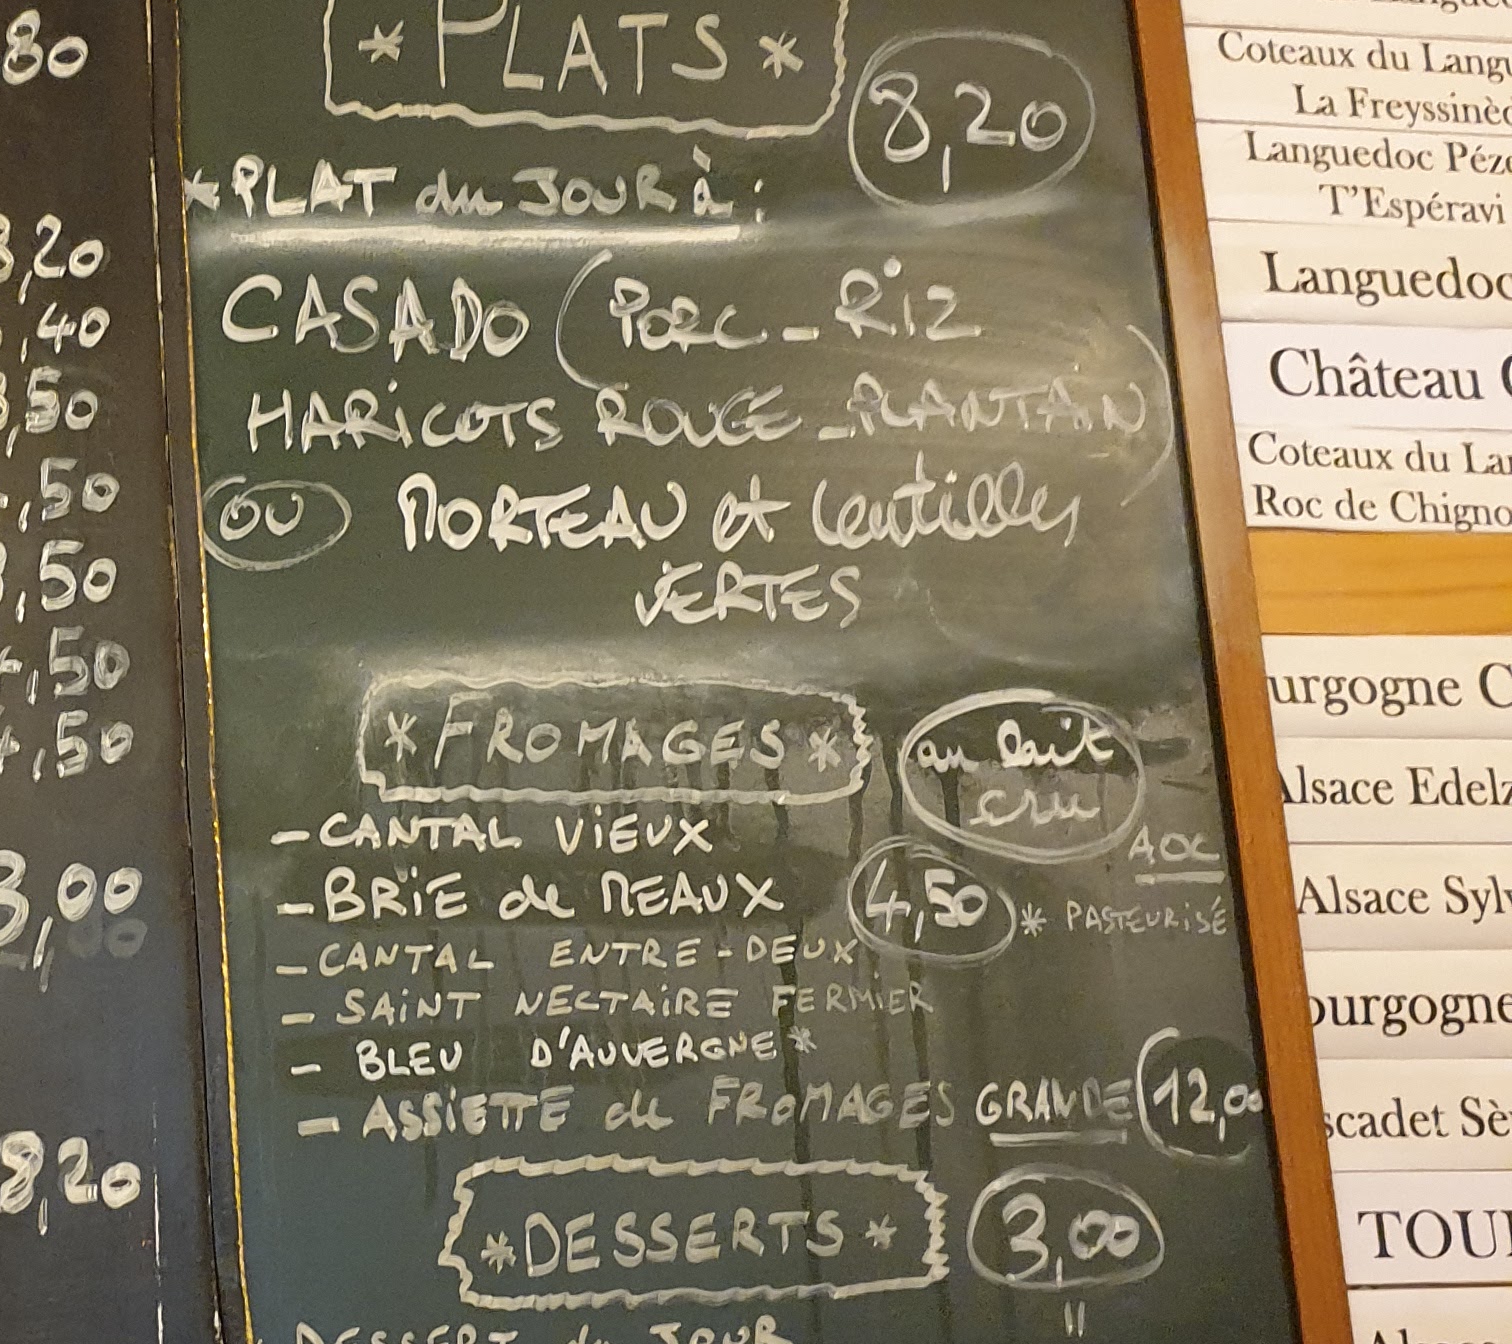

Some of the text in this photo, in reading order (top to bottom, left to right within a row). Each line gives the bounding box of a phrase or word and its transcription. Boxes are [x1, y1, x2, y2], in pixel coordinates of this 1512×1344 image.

[1218, 31, 1409, 70] Coteaux du
[1293, 83, 1335, 118] La
[868, 70, 1067, 192] 8,20
[1245, 130, 1435, 171] Languedoc
[231, 156, 396, 219] PLAT
[512, 168, 675, 216] JOUR
[221, 275, 531, 361] CASADO
[1270, 347, 1485, 400] Château
[1249, 431, 1450, 472] Coteaux du
[396, 472, 688, 552] MORTEAU
[1252, 484, 1378, 521] Roc de
[435, 692, 786, 769] FROMAGES
[319, 812, 523, 850] CANTAL
[498, 865, 988, 944] de MEAUX 4,50
[1298, 875, 1429, 914] Alsace
[318, 942, 496, 977] CANTAL
[357, 1040, 463, 1078] BLEU
[707, 1078, 1134, 1129] FROMAGES GRANDE
[525, 1192, 1140, 1290] DESSERTS 3,00
